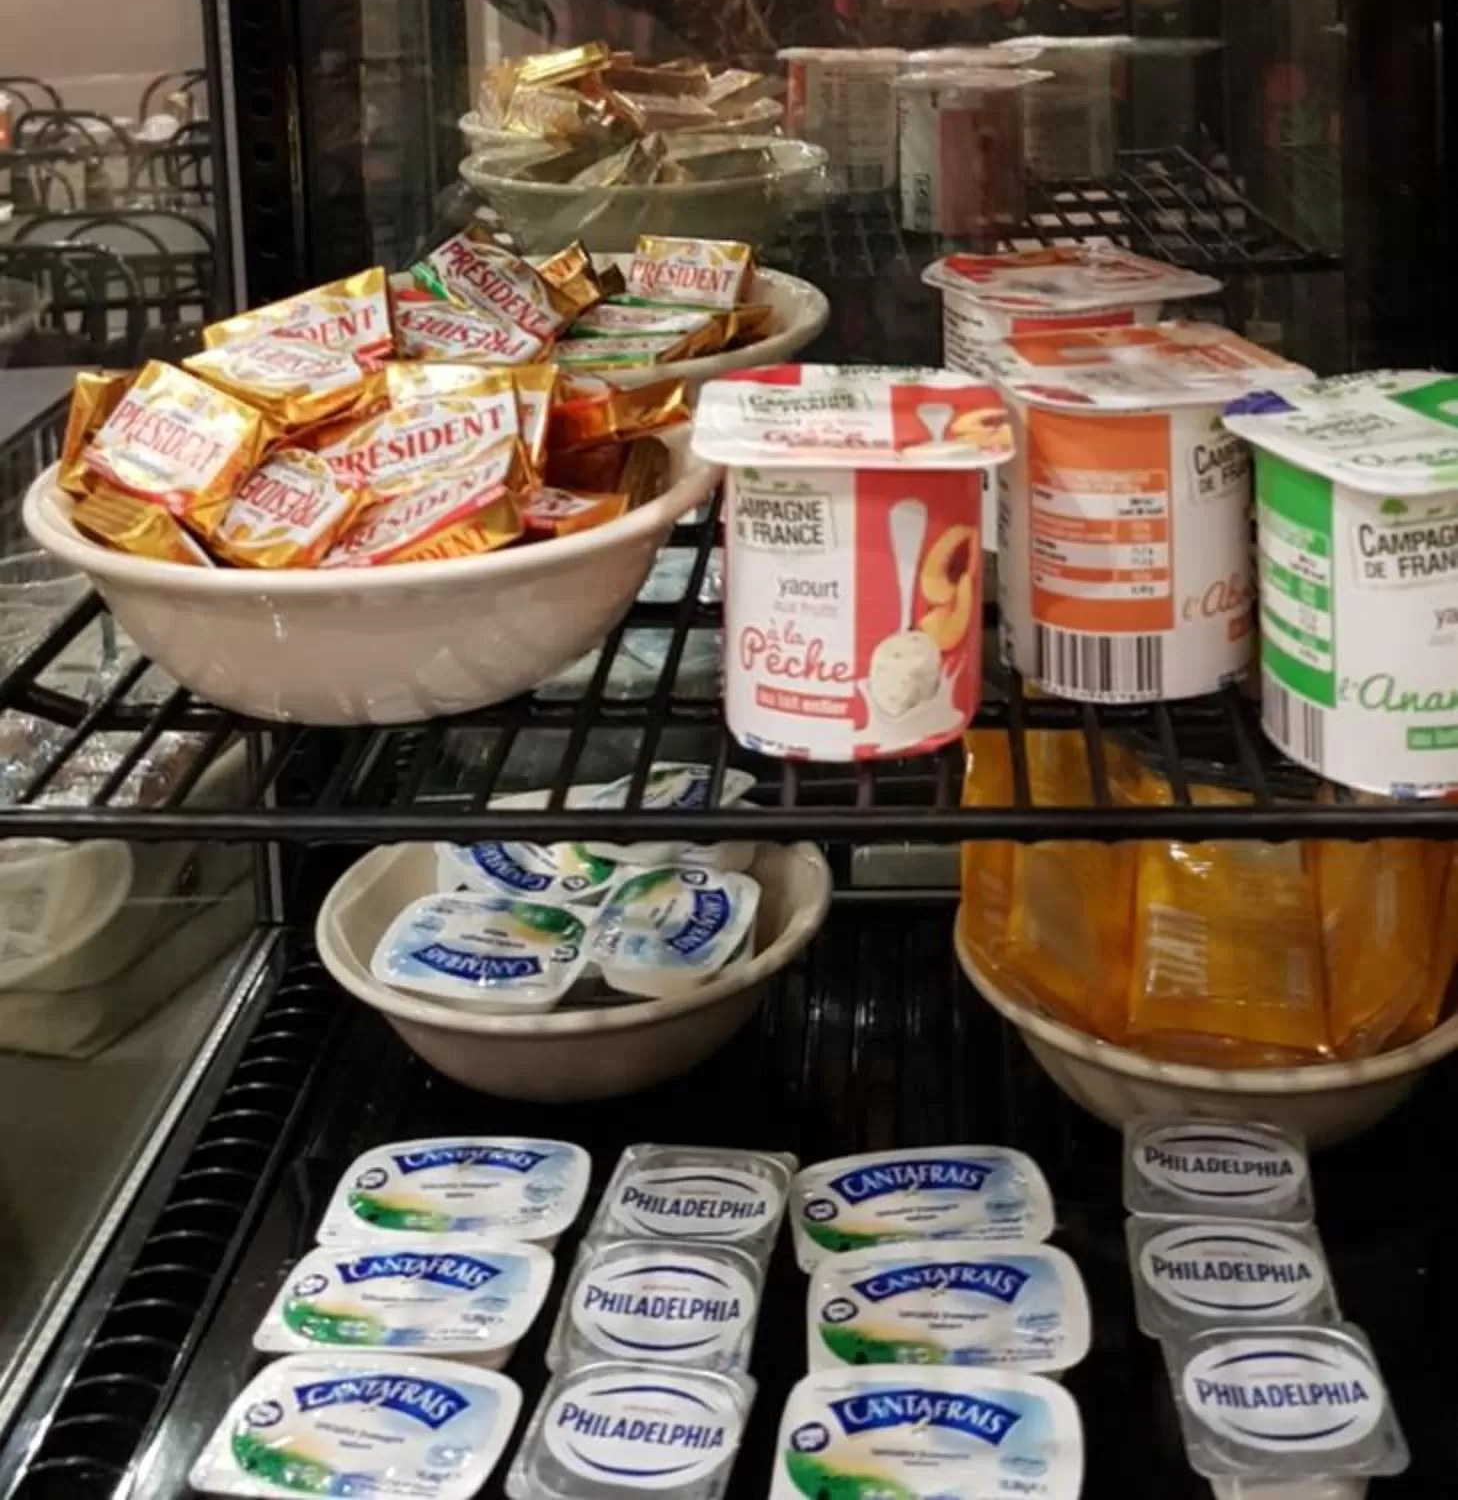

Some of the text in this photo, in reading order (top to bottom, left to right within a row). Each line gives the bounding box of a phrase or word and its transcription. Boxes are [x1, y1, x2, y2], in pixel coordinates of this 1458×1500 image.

[736, 496, 825, 522] AMPAGNE
[751, 521, 825, 547] FRANCE
[1358, 522, 1458, 559] CAMPAG
[1363, 560, 1388, 581] DE
[777, 577, 840, 601] yaourt
[738, 625, 862, 685] Pêche
[1144, 1146, 1294, 1177] PHILADELPHIA
[842, 1163, 981, 1198] CANTAFRAIS
[621, 1187, 768, 1220] PHILADELPHIA
[349, 1253, 492, 1288] CANTAFRAIS
[866, 1266, 1015, 1298] CANTAFRAIS
[1151, 1254, 1312, 1282] PHILADELPHIA
[583, 1285, 742, 1322] PHILADELPHIA
[305, 1379, 459, 1425] CANTAFRAIS
[1195, 1378, 1369, 1409] PHILADELPHIA
[557, 1403, 725, 1451] PHILADELPHIA
[843, 1393, 1007, 1435] CANTAFRAIS
